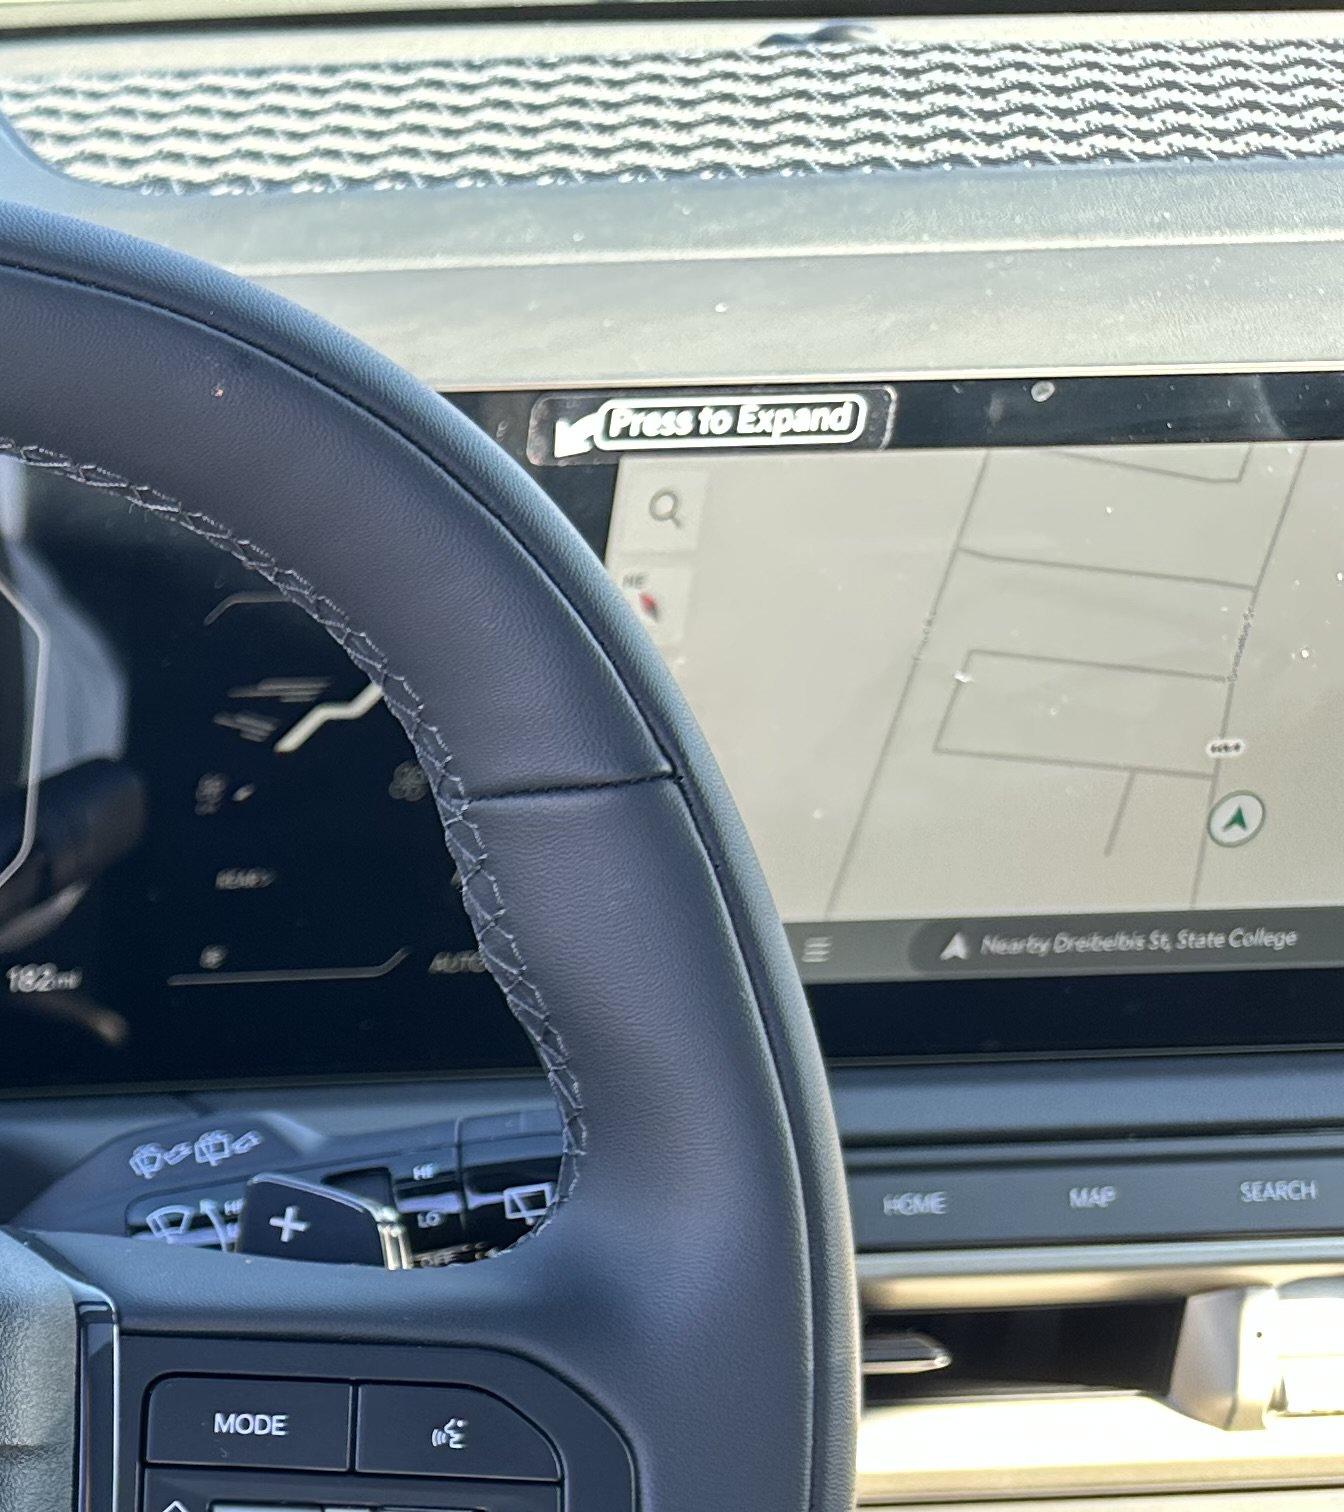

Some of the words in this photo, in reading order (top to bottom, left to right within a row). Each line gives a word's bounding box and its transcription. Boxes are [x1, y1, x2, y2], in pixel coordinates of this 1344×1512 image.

[609, 407, 695, 437] Press
[698, 406, 734, 434] to
[737, 400, 854, 438] Expand
[980, 933, 1050, 957] Nearby
[1175, 928, 1226, 951] State
[1228, 926, 1298, 951] College
[1069, 1185, 1116, 1208] MAP
[1239, 1179, 1318, 1202] SEARCH
[883, 1191, 947, 1215] HOME
[213, 1412, 289, 1437] MODE
